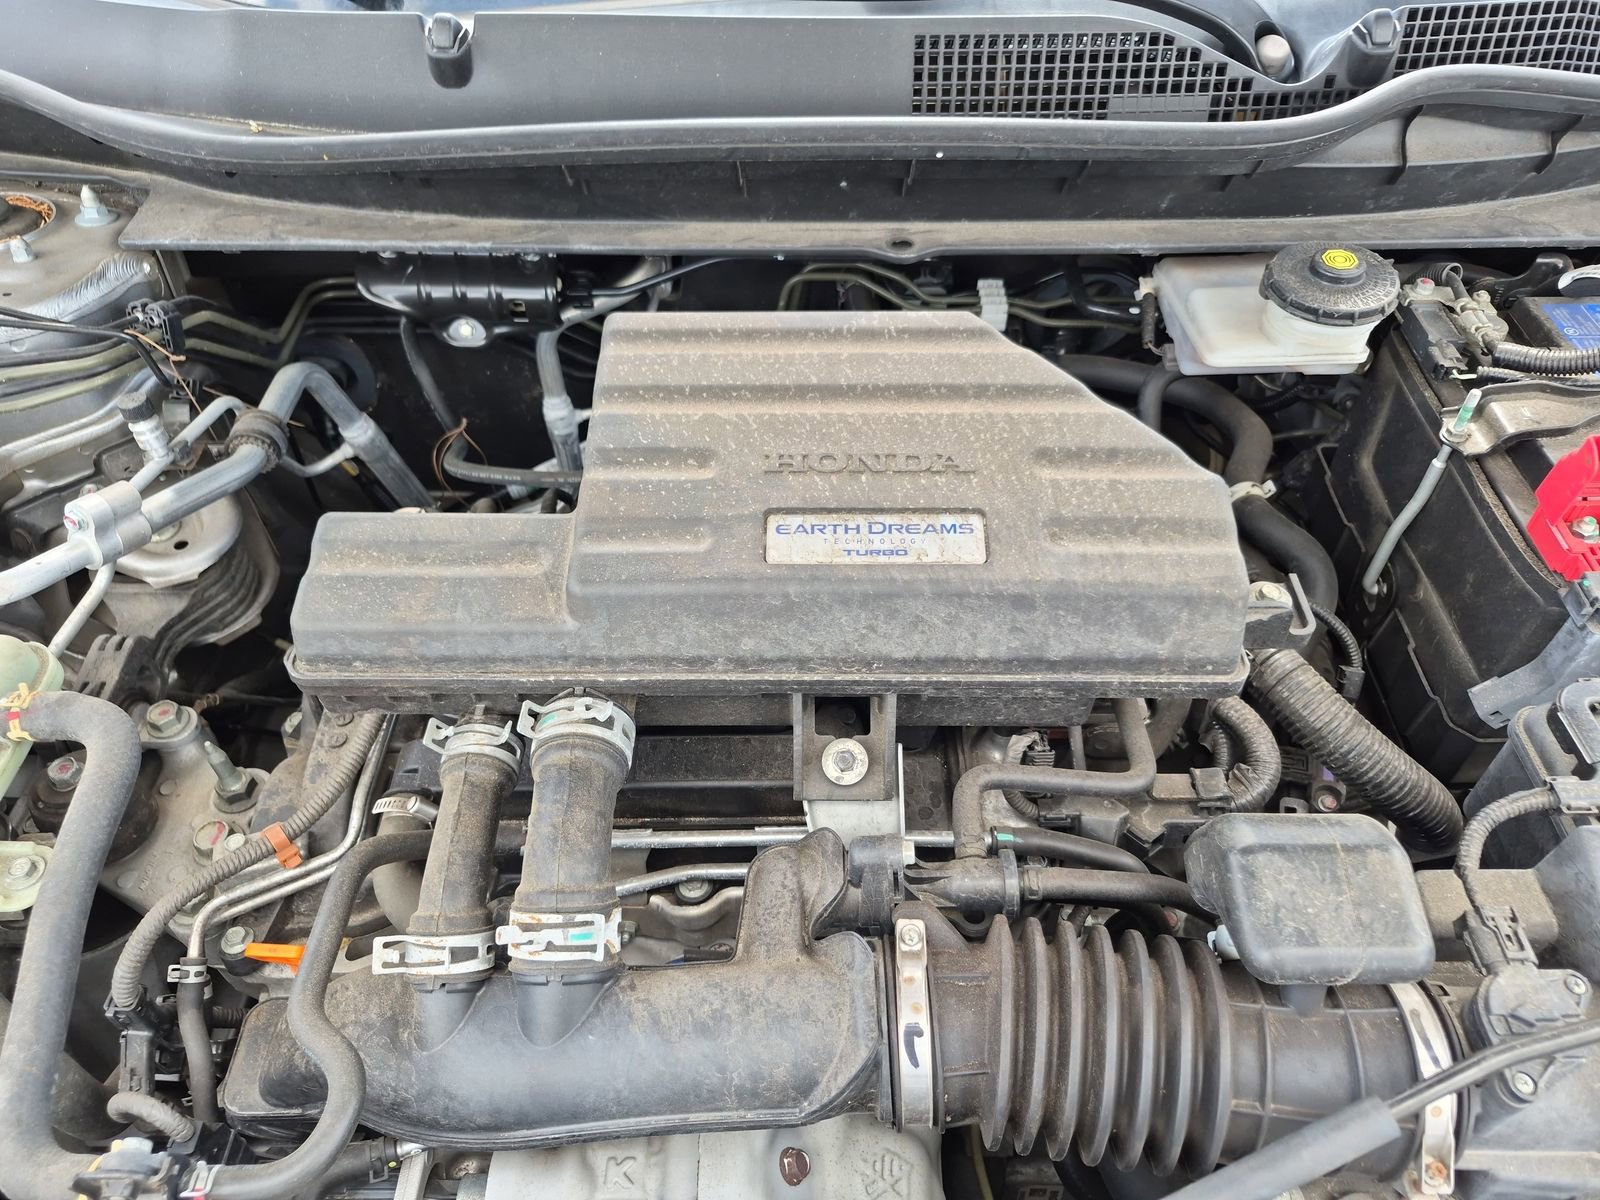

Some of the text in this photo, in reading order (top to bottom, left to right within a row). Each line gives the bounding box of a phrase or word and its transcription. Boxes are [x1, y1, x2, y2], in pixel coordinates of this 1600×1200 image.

[764, 453, 976, 475] HONDA
[775, 521, 975, 535] EARTH DREAMS
[843, 549, 909, 557] TURBO
